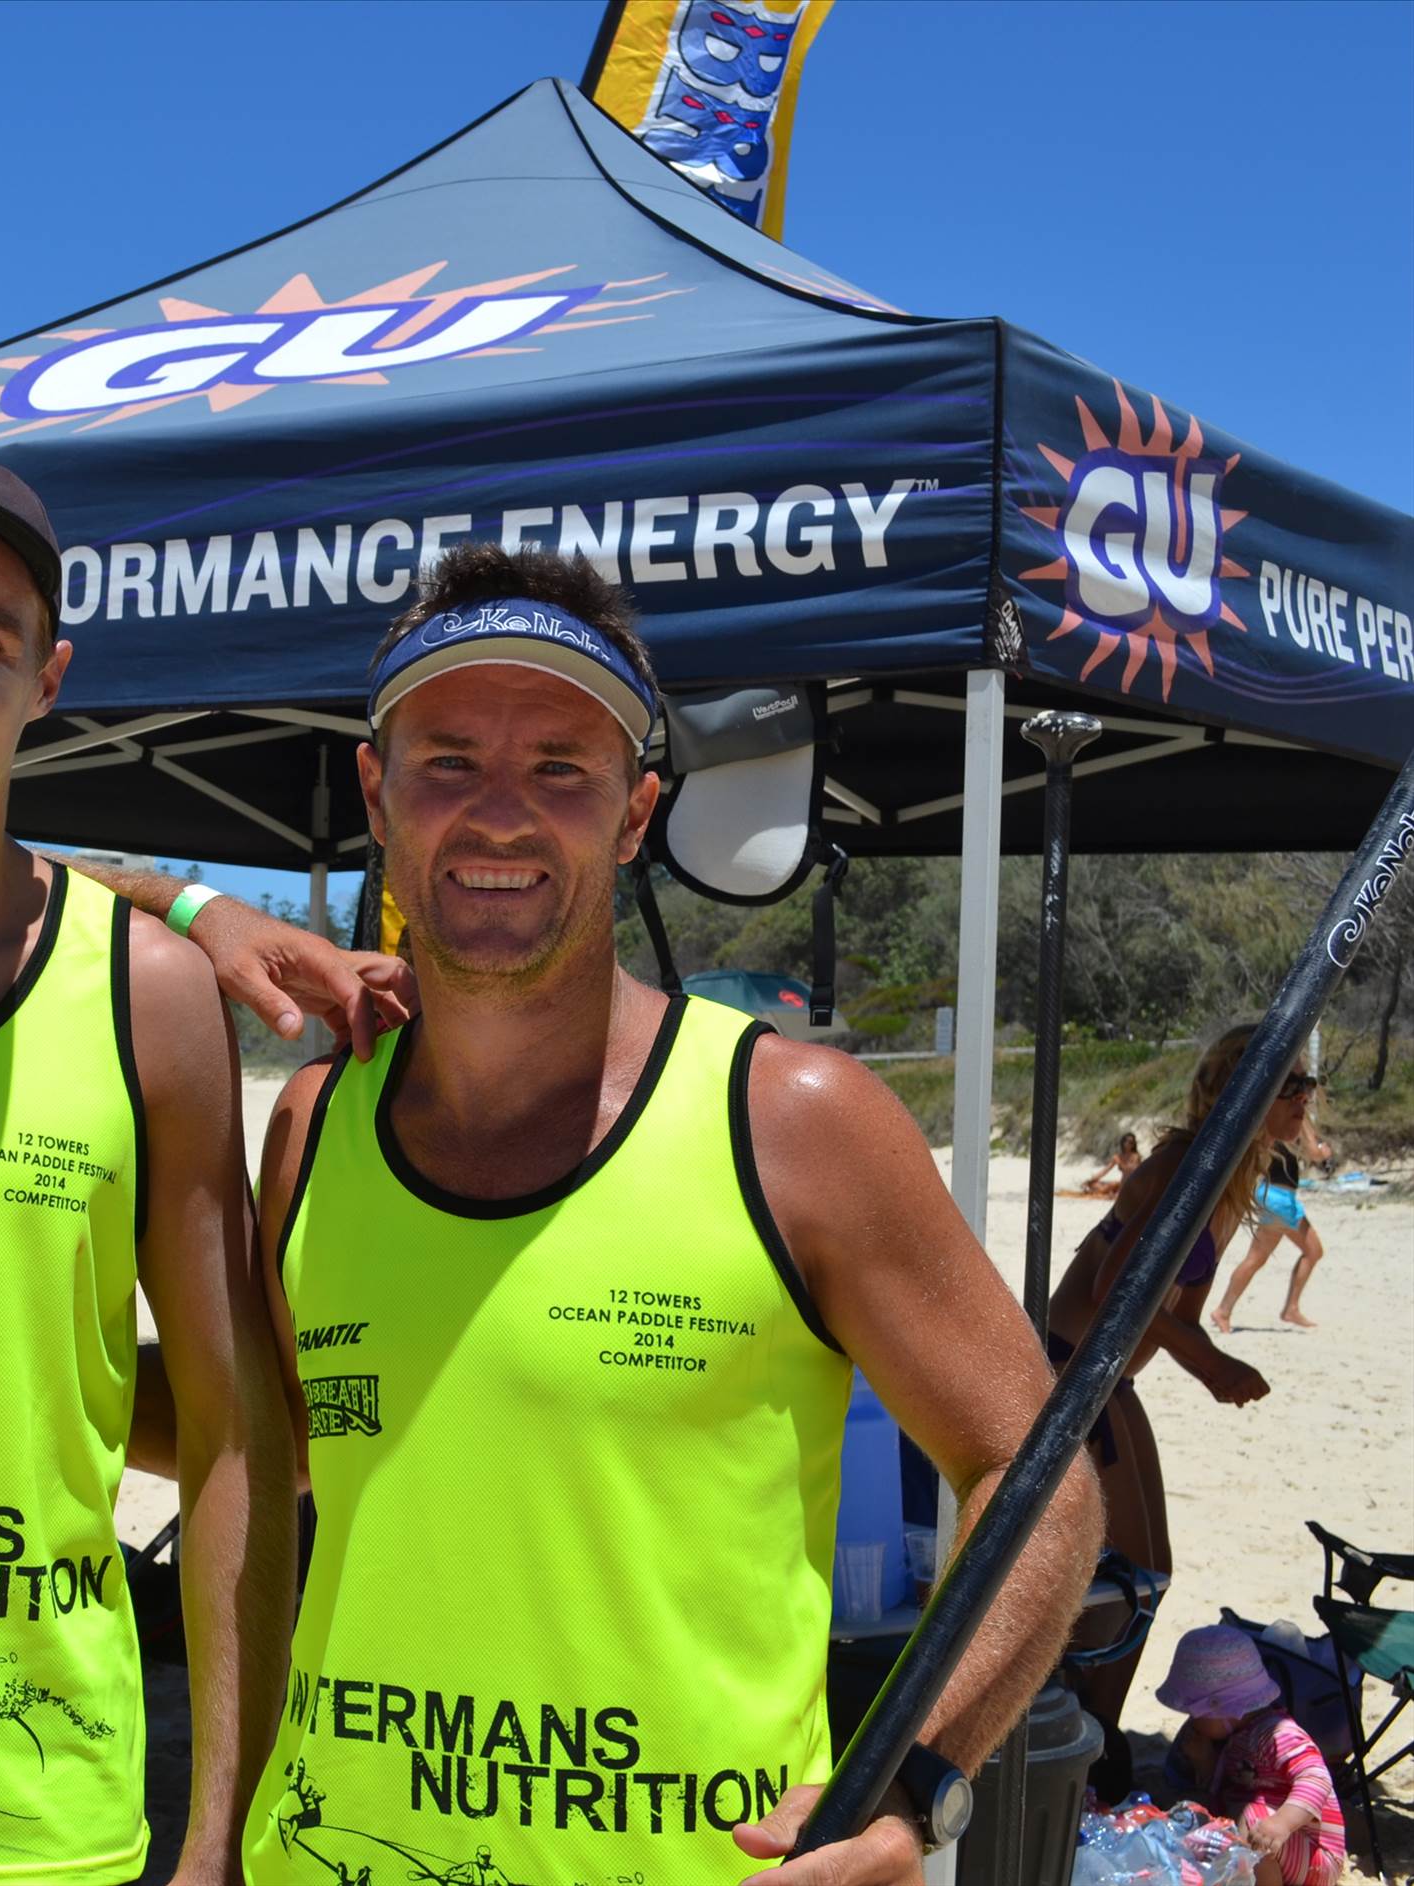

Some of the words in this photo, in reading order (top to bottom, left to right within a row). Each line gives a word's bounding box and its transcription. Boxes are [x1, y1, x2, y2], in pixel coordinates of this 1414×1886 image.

[639, 0, 802, 228] BR
[27, 295, 571, 412] GU
[1062, 465, 1217, 617] GU
[1259, 559, 1355, 664] PURE
[18, 1132, 34, 1146] 12
[38, 1135, 90, 1156] TOWERS
[23, 1152, 75, 1172] PADDLE
[77, 1161, 118, 1185] FESTIVAL
[34, 1173, 66, 1190] 2014
[3, 1188, 87, 1213] COMPETITOR
[610, 1289, 628, 1304] 12
[633, 1291, 702, 1311] TOWERS
[548, 1306, 611, 1323] OCEAN
[617, 1310, 684, 1329] PADDLE
[689, 1317, 757, 1336] FESTIVAL
[297, 1322, 370, 1354] FANATIC
[634, 1332, 675, 1349] 2014
[599, 1350, 707, 1372] COMPETITOR
[411, 1751, 788, 1834] NUTRITION
